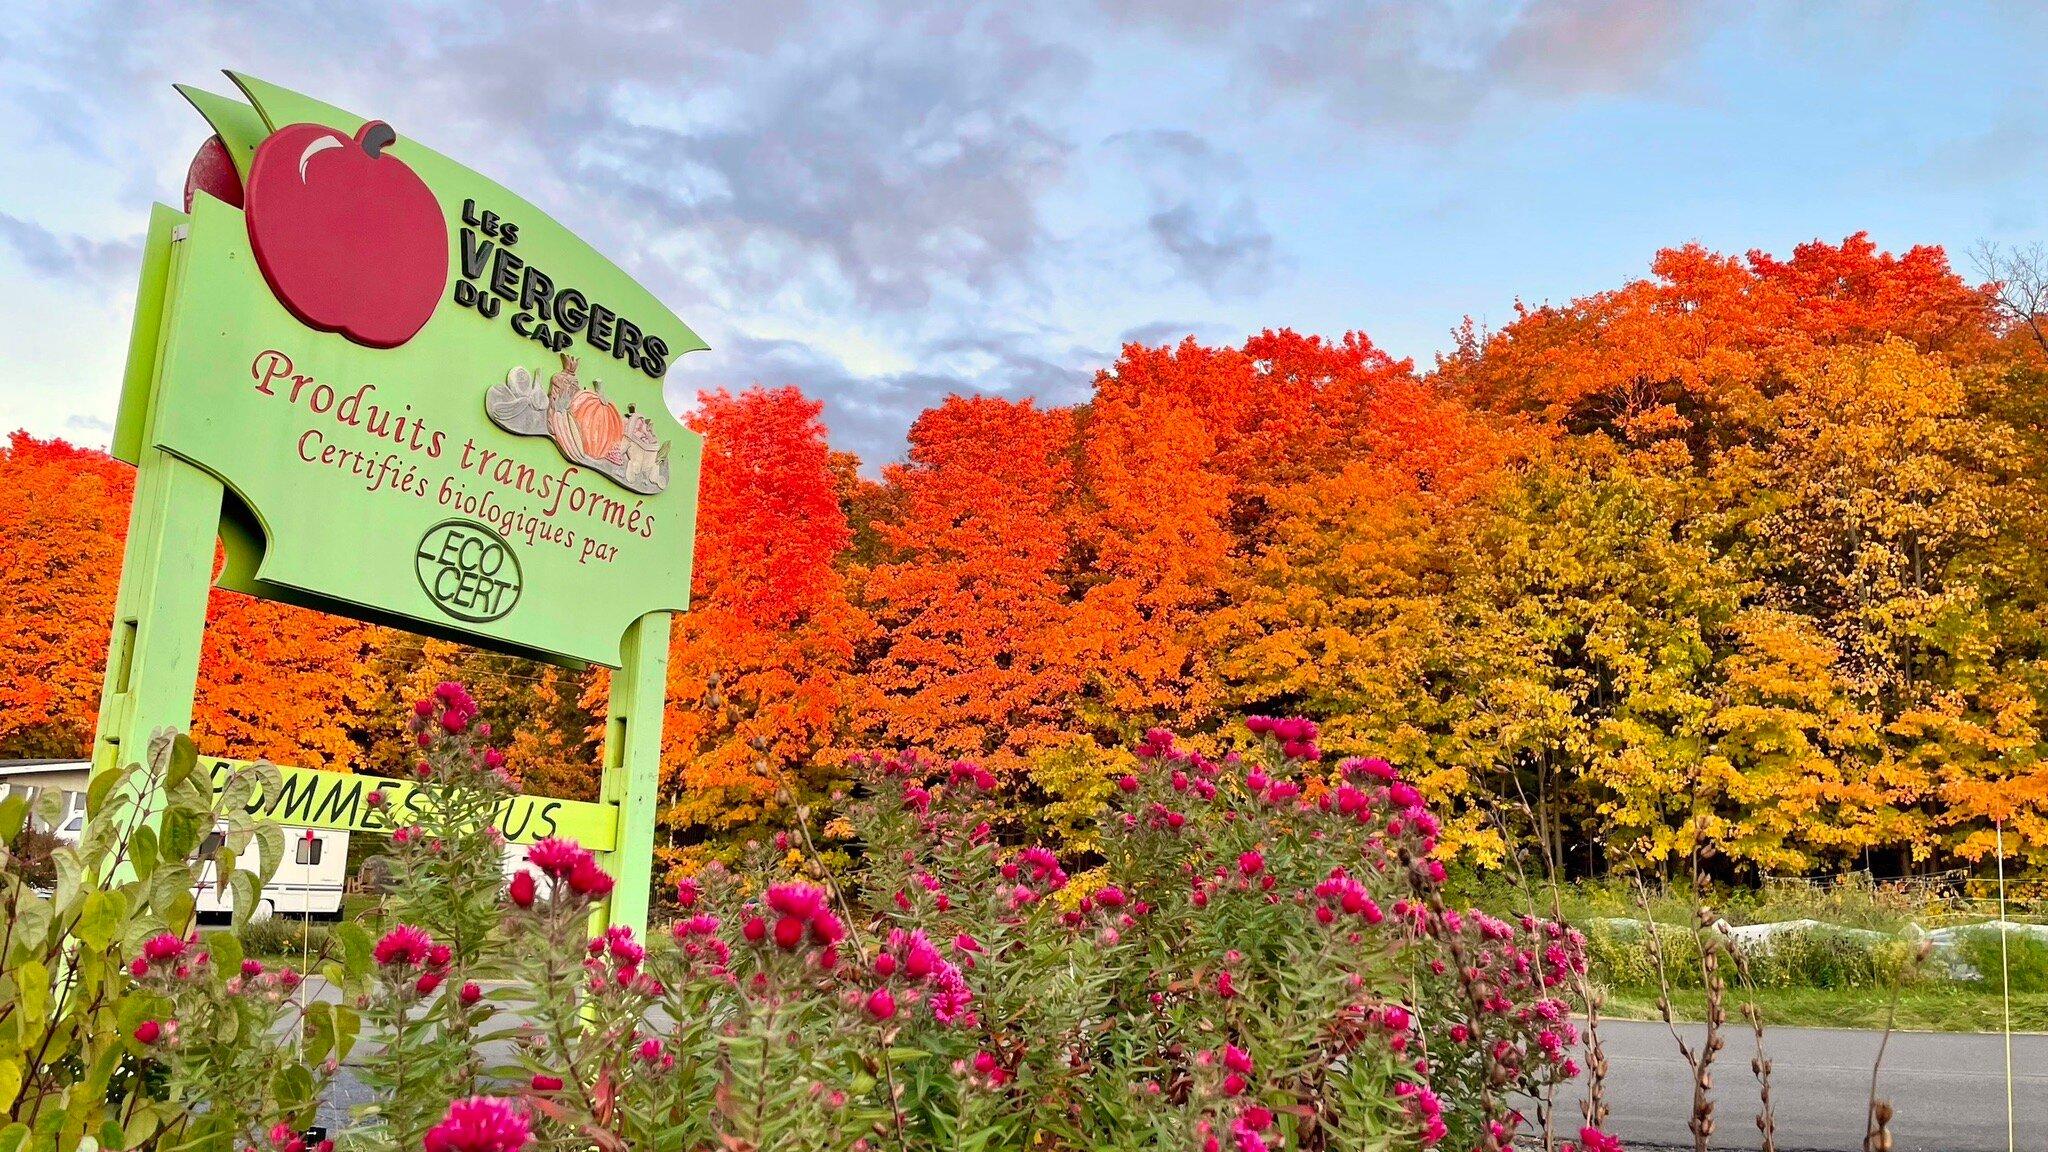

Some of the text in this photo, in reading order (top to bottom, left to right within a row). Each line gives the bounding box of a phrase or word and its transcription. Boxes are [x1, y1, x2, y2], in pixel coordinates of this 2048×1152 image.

[463, 198, 519, 246] LES
[454, 279, 573, 352] DU CAP
[460, 227, 669, 379] VERGERS
[252, 350, 656, 539] Produits transformés
[297, 429, 618, 564] Certifiés biologiques par
[437, 530, 503, 576] ECO
[435, 566, 511, 614] CERT
